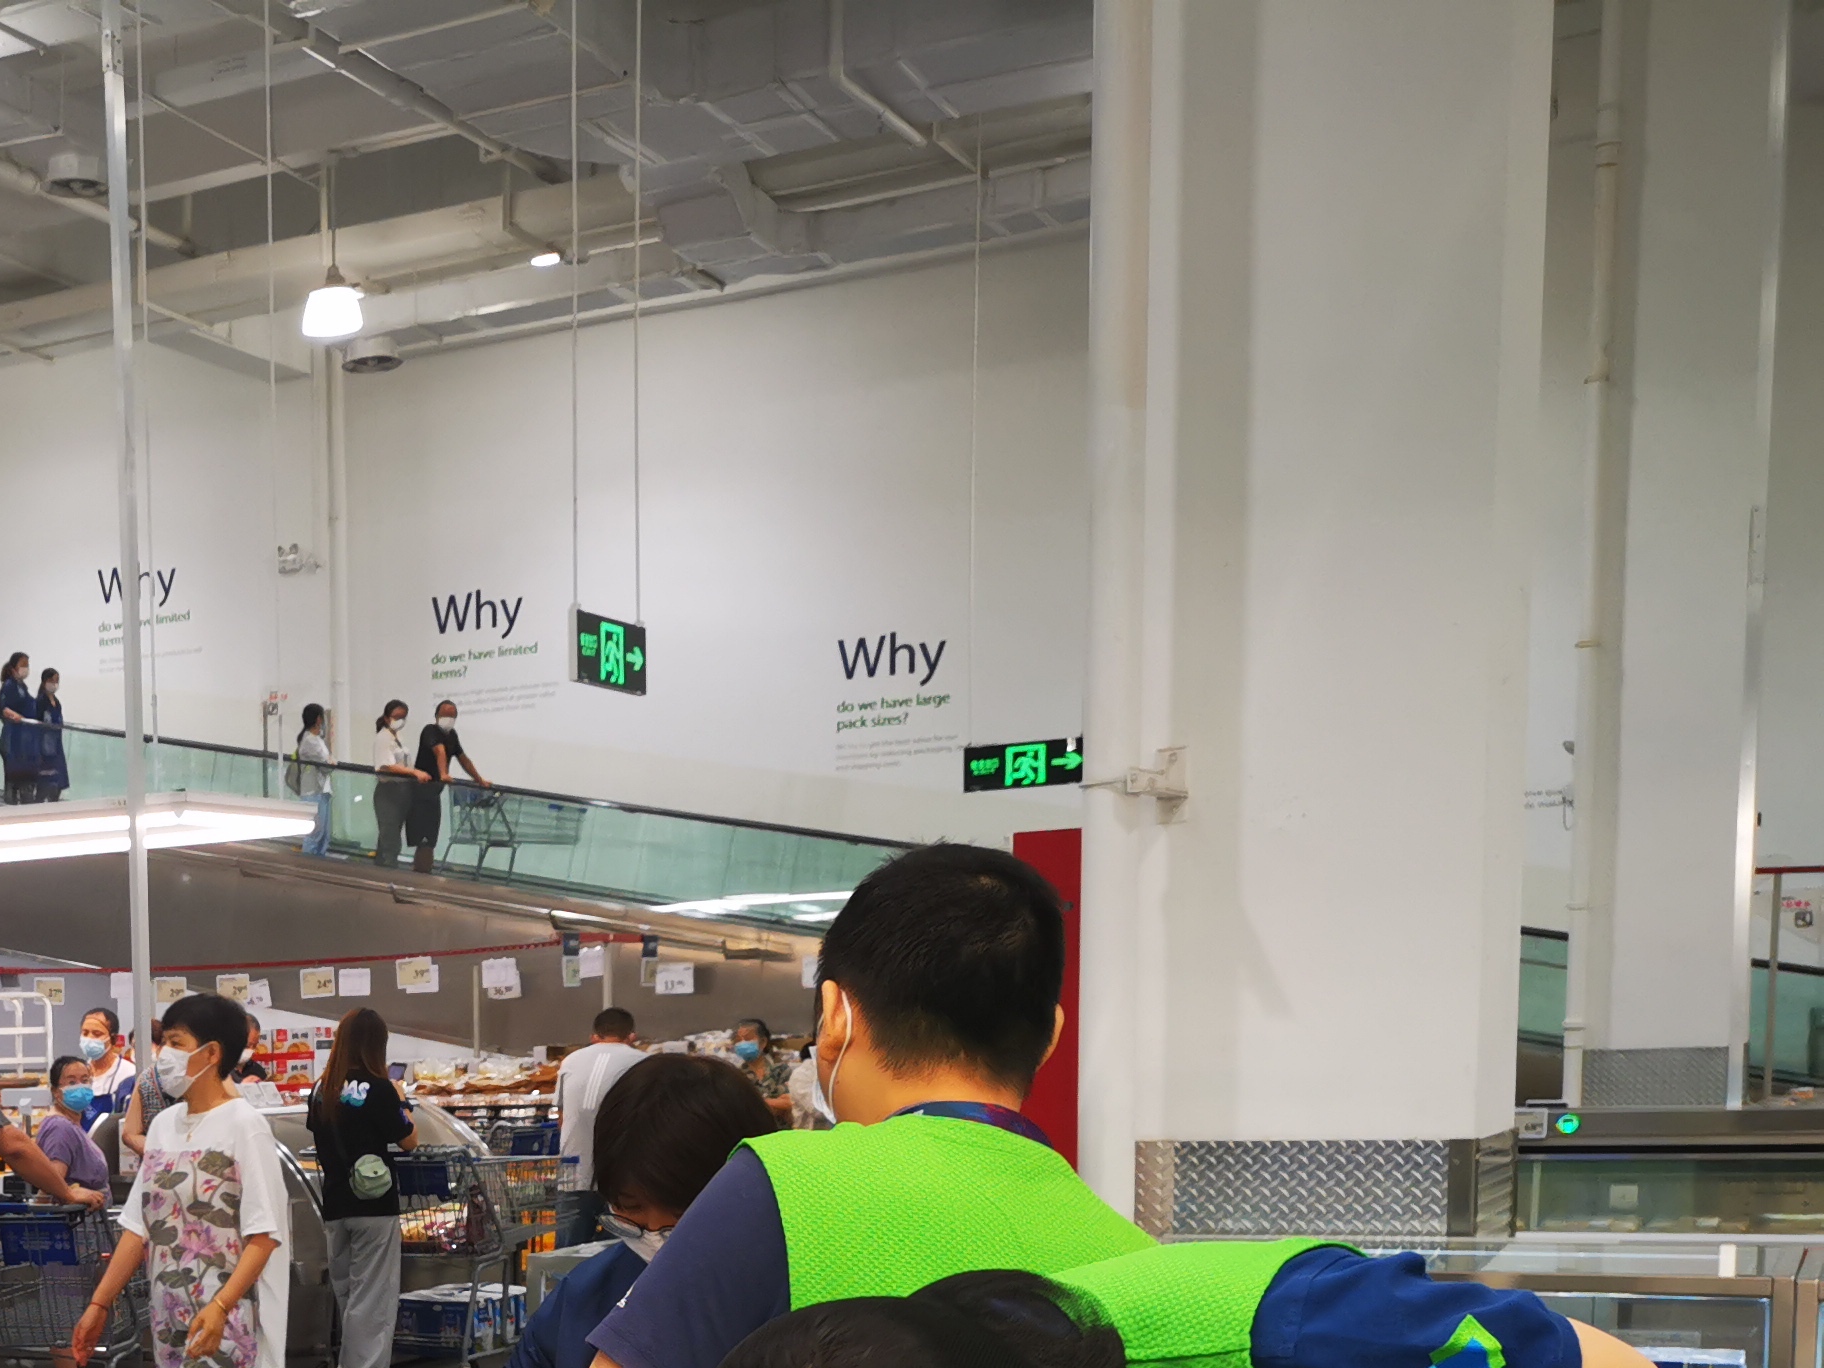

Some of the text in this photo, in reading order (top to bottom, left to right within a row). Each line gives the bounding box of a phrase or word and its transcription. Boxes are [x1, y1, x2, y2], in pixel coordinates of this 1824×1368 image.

[431, 589, 523, 640] Why
[431, 641, 539, 665] do we have limited
[837, 631, 947, 687] Why
[431, 665, 468, 681] items?
[836, 692, 951, 714] do we have large
[836, 712, 909, 734] pack sizes?
